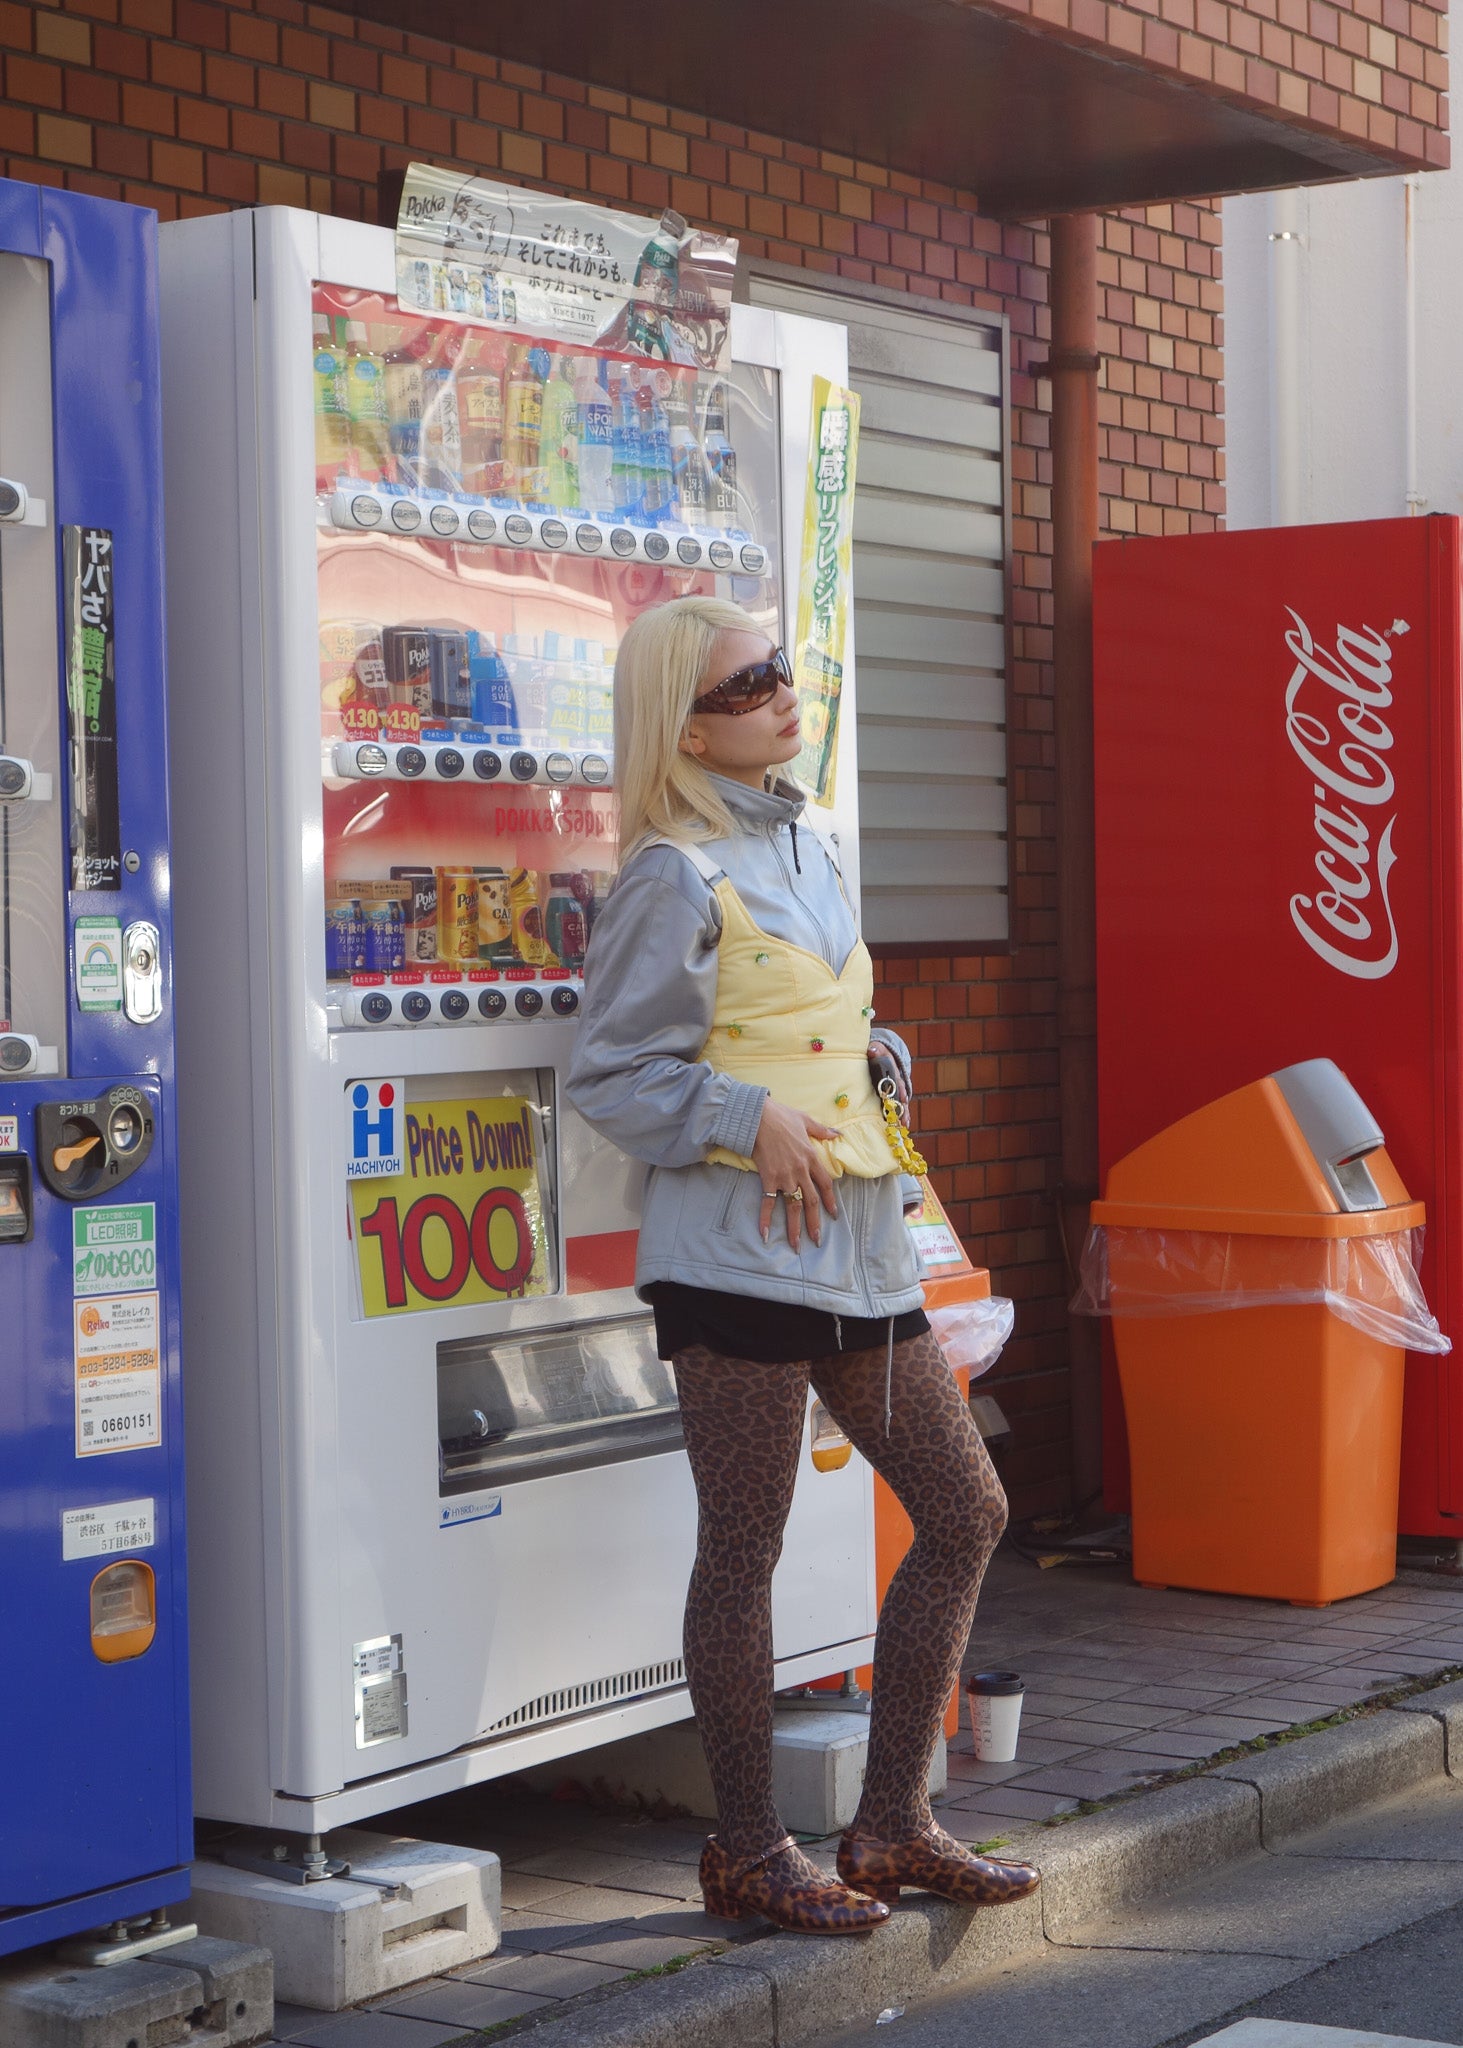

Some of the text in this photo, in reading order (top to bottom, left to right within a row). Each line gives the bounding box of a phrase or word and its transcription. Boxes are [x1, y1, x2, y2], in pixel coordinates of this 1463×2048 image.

[407, 195, 446, 217] Pokka
[518, 241, 627, 284] そしてこれからも。
[1285, 605, 1398, 980] Coca-Cola
[60, 1103, 96, 1116] おつり・返却
[406, 1106, 533, 1178] Price Down!
[347, 1158, 400, 1176] HACHIYOH
[91, 1223, 138, 1241] LED照明
[94, 1248, 155, 1279] のむeco
[87, 1319, 110, 1333] Reika
[87, 1353, 154, 1373] 03-5284-5284
[102, 1413, 151, 1433] 0660151
[80, 1517, 147, 1537] 渋谷区 千駄ヶ谷
[101, 1532, 152, 1551] 5丁目6番8号
